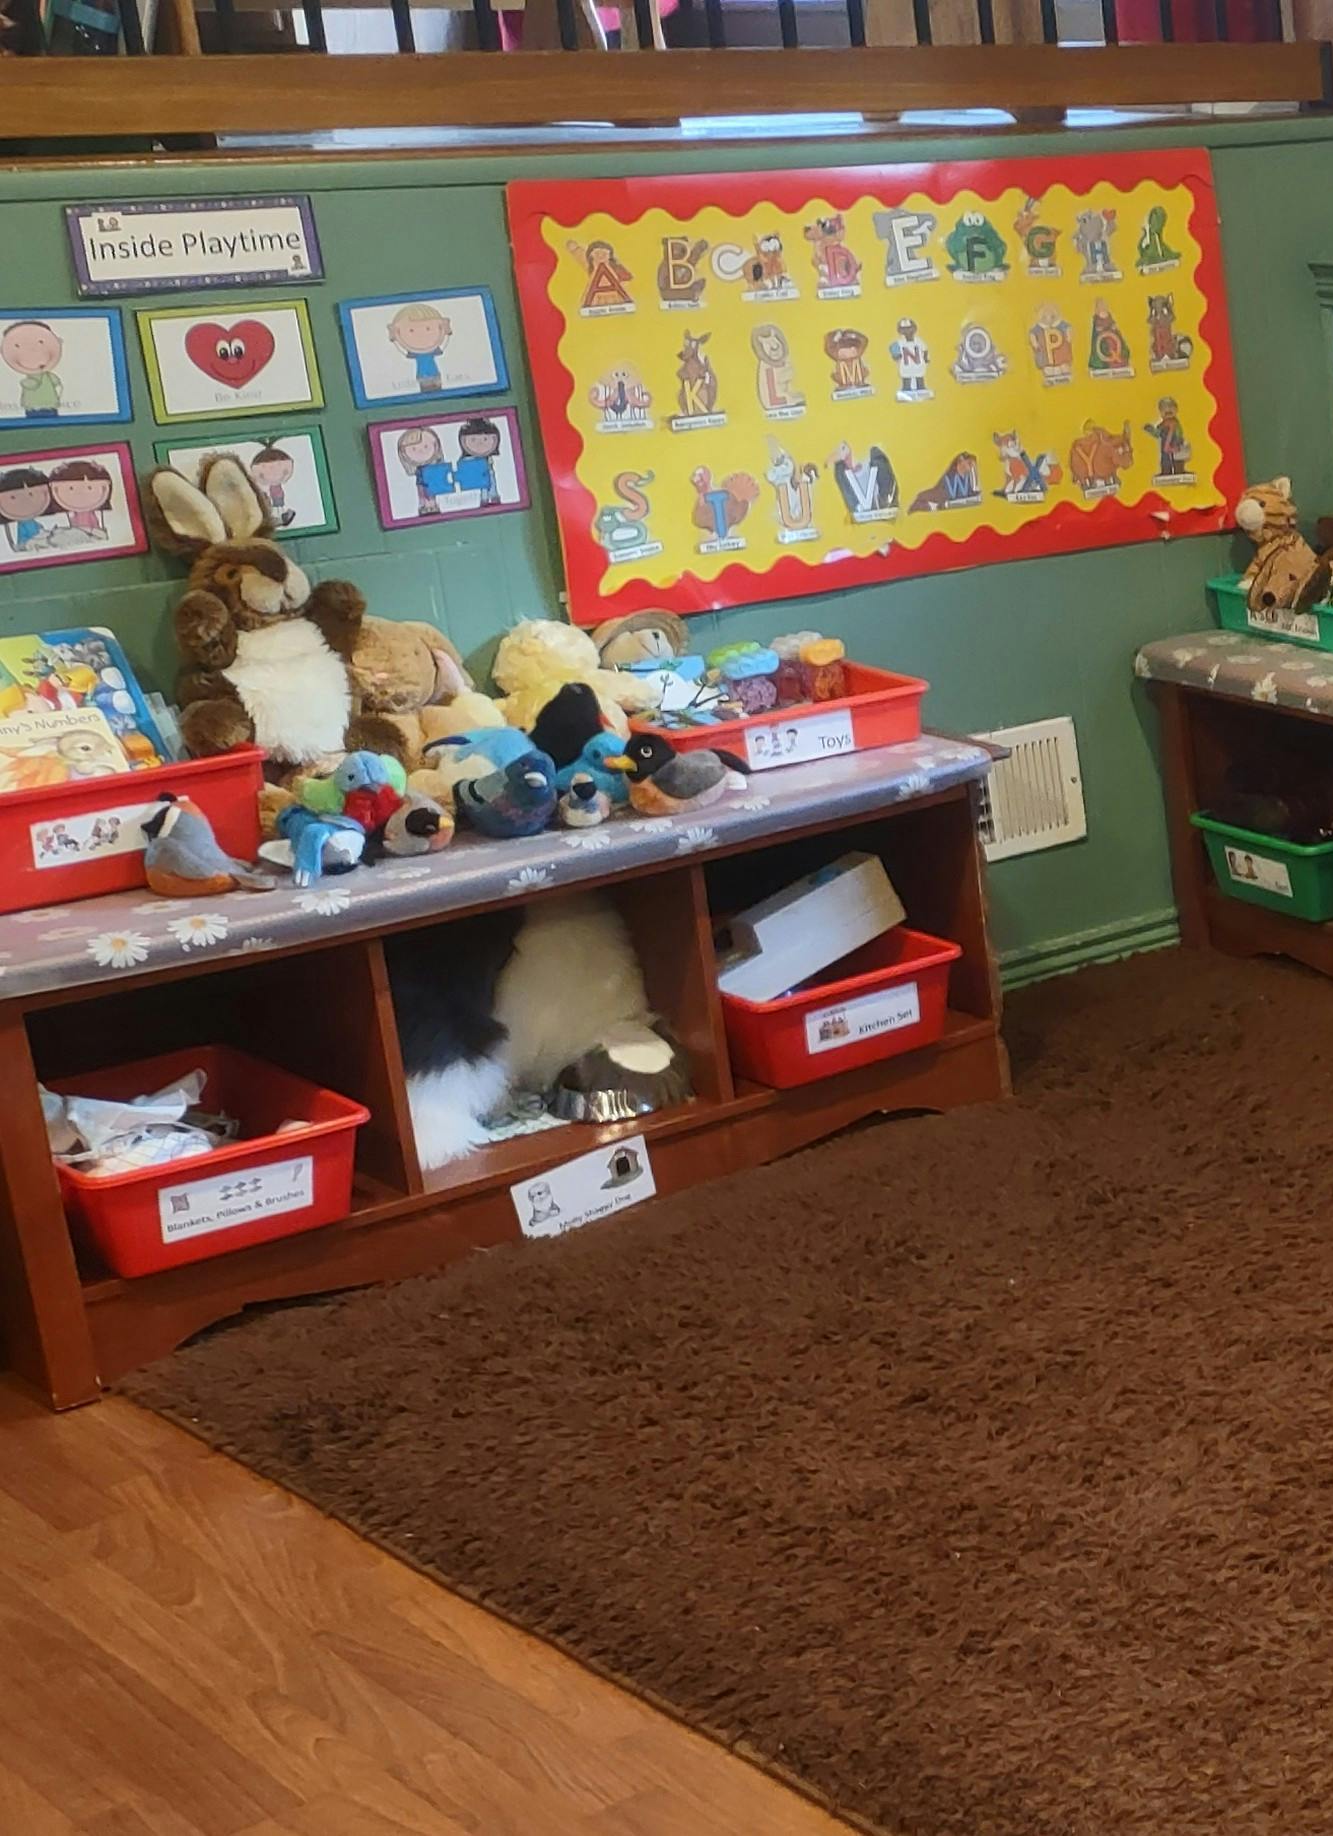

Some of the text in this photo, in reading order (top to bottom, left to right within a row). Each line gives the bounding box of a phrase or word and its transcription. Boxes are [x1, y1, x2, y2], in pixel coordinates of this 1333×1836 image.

[90, 228, 301, 261] Inside Playtime
[892, 215, 930, 272] E
[965, 236, 988, 272] F
[1026, 225, 1056, 258] G
[666, 237, 697, 290] B
[711, 243, 746, 282] C
[584, 262, 632, 307] A
[901, 345, 922, 366] N
[964, 328, 992, 358] O
[1045, 328, 1063, 367] P
[1096, 330, 1124, 365] Q
[765, 366, 788, 407] L
[838, 361, 865, 387] M
[683, 378, 711, 416] K
[1074, 443, 1100, 477] Y
[614, 471, 651, 521] S
[845, 466, 878, 510] V
[943, 474, 970, 499] W
[703, 489, 731, 539] T
[777, 482, 812, 529] U
[34, 712, 101, 730] Numbers
[817, 733, 851, 750] Toys
[859, 1009, 913, 1035] Kitchen Set
[216, 1204, 253, 1220] Pillows
[254, 1200, 264, 1209] &
